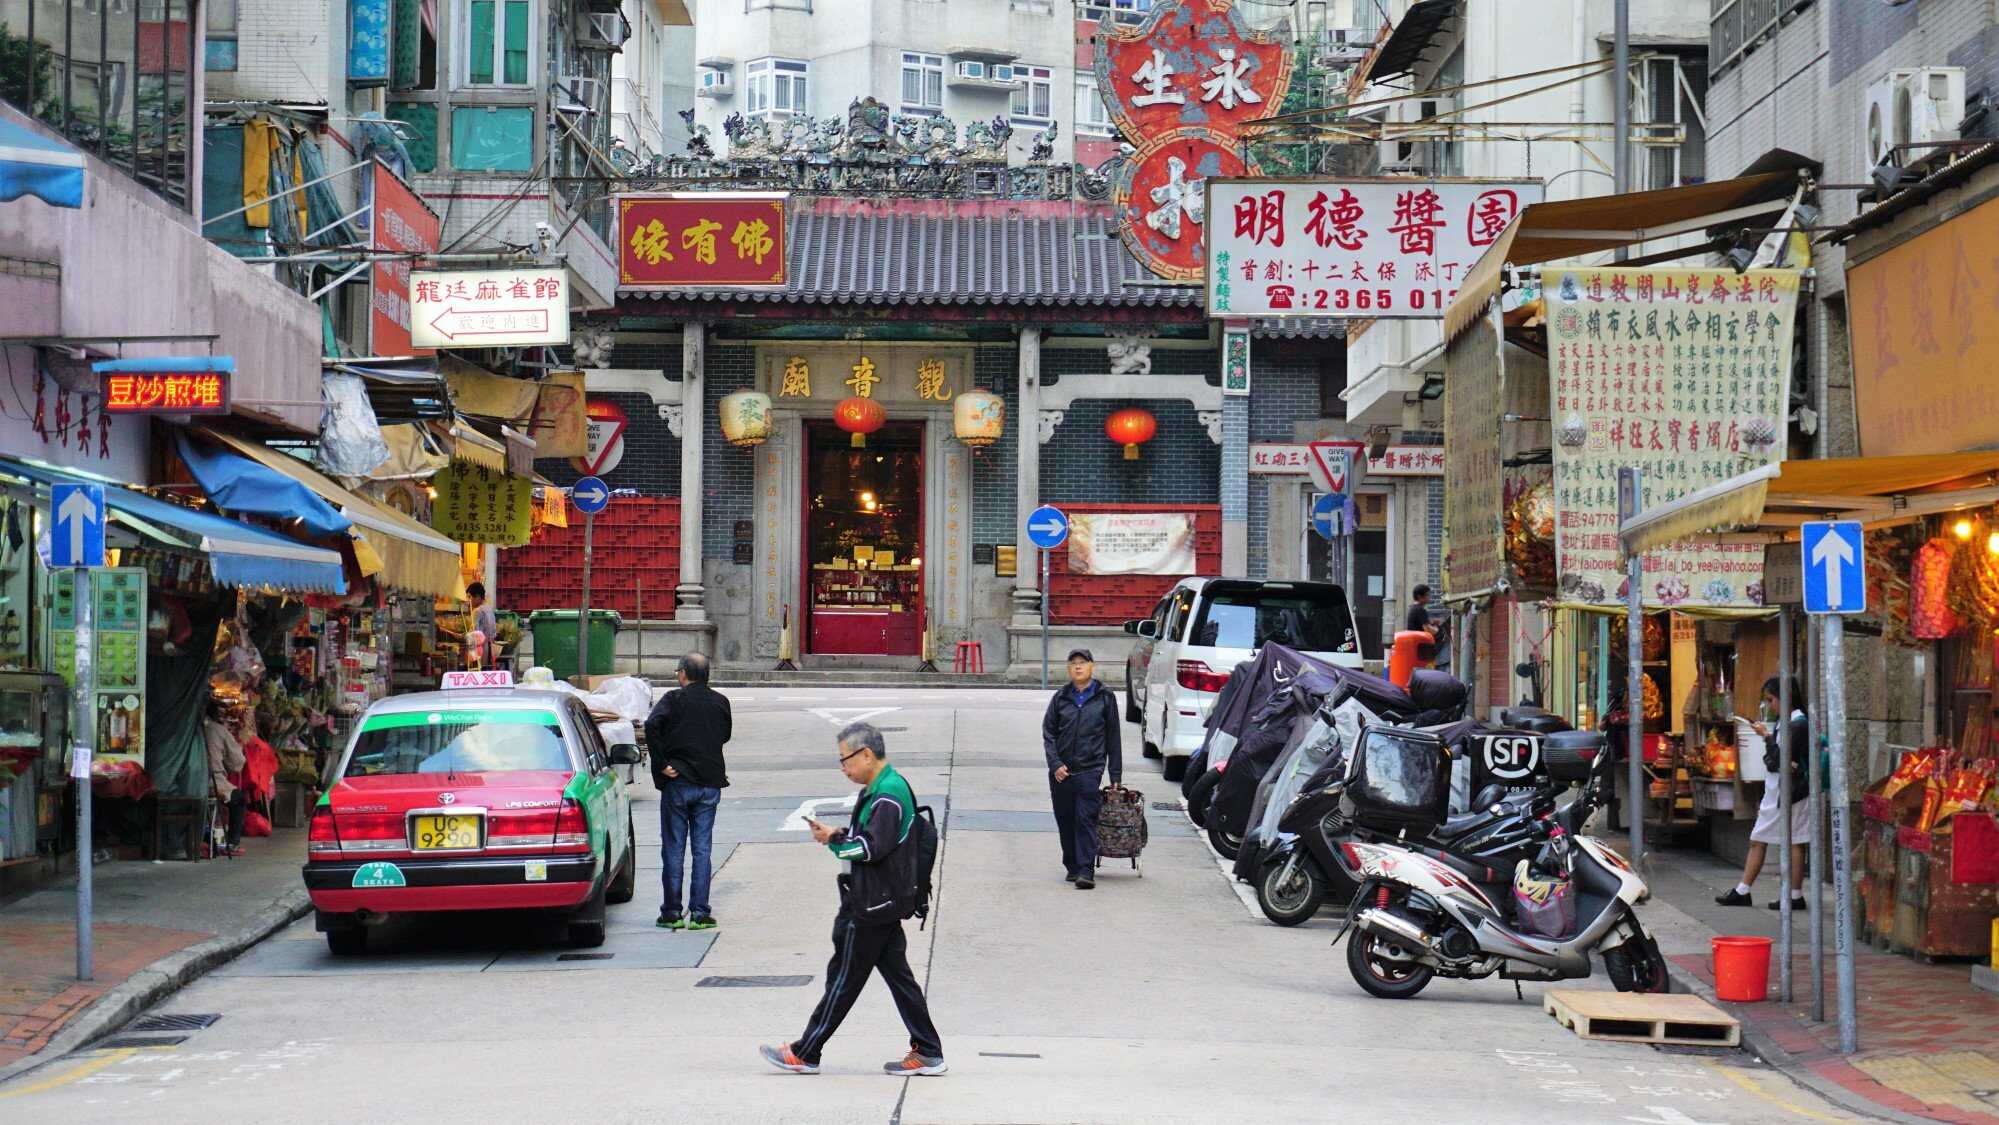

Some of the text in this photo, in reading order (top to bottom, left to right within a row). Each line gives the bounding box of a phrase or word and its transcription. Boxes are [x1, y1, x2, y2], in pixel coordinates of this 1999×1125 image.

[1233, 188, 1518, 256] 明德醬園
[1415, 261, 1474, 281] 添丁
[108, 374, 221, 407] 豆沙煎堆
[1328, 455, 1345, 463] WAY
[448, 673, 507, 686] TAXI
[433, 816, 459, 832] UC
[421, 832, 473, 848] 9290
[373, 868, 384, 879] 4
